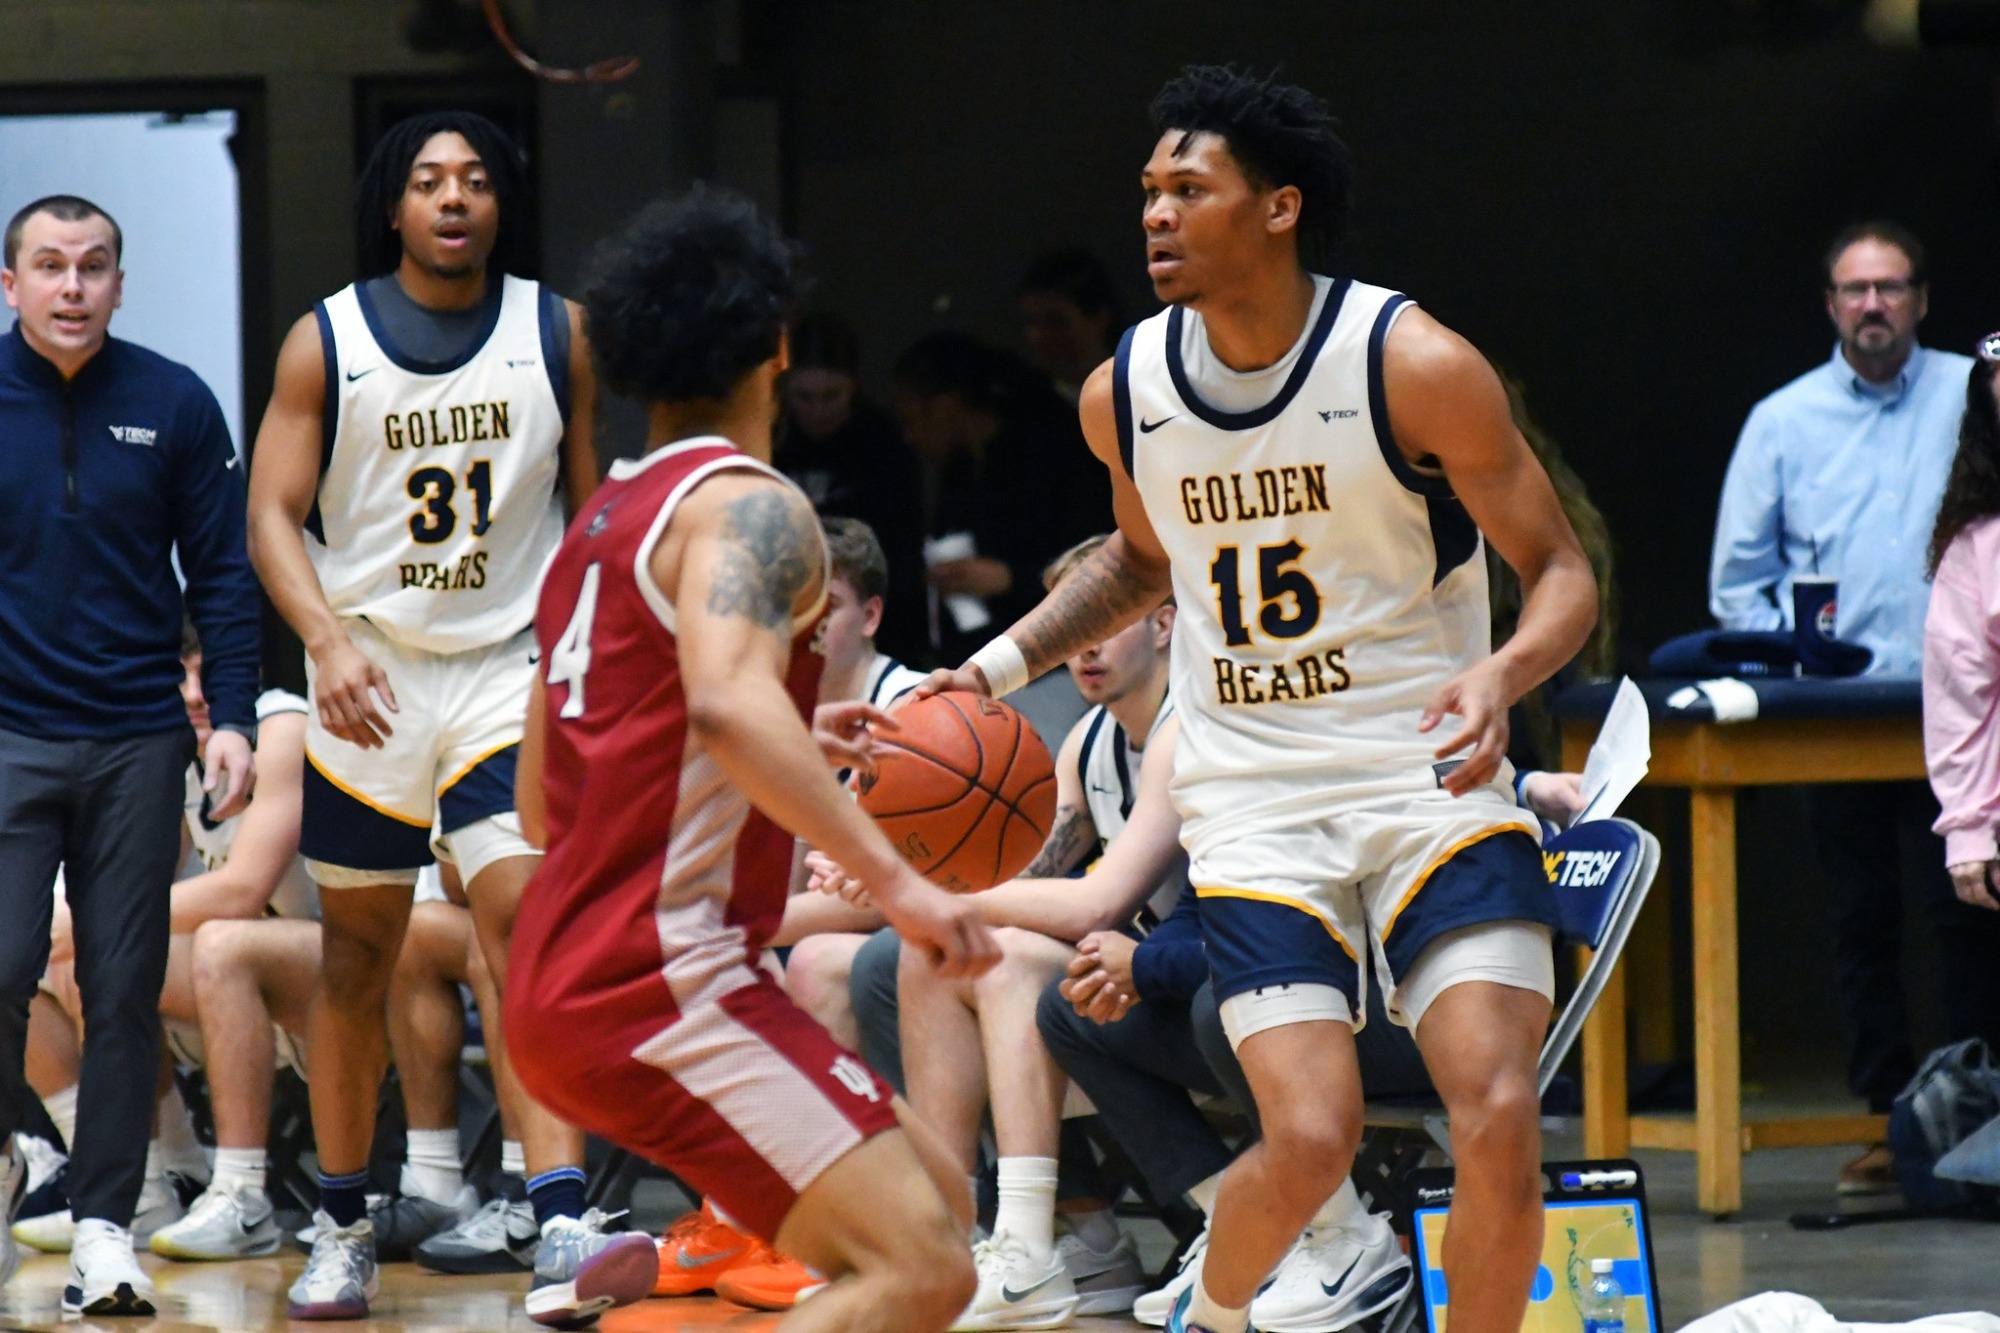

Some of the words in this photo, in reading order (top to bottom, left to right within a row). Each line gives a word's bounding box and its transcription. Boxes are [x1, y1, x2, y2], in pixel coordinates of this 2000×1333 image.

[124, 427, 157, 441] TECH
[384, 401, 511, 451] GOLDEN
[1332, 409, 1359, 419] TECH
[405, 459, 494, 545] 31
[1181, 465, 1331, 524] GOLDEN
[1209, 537, 1323, 646] 15
[546, 561, 601, 719] 4
[1213, 648, 1351, 704] BEARS
[1559, 851, 1621, 887] TECH
